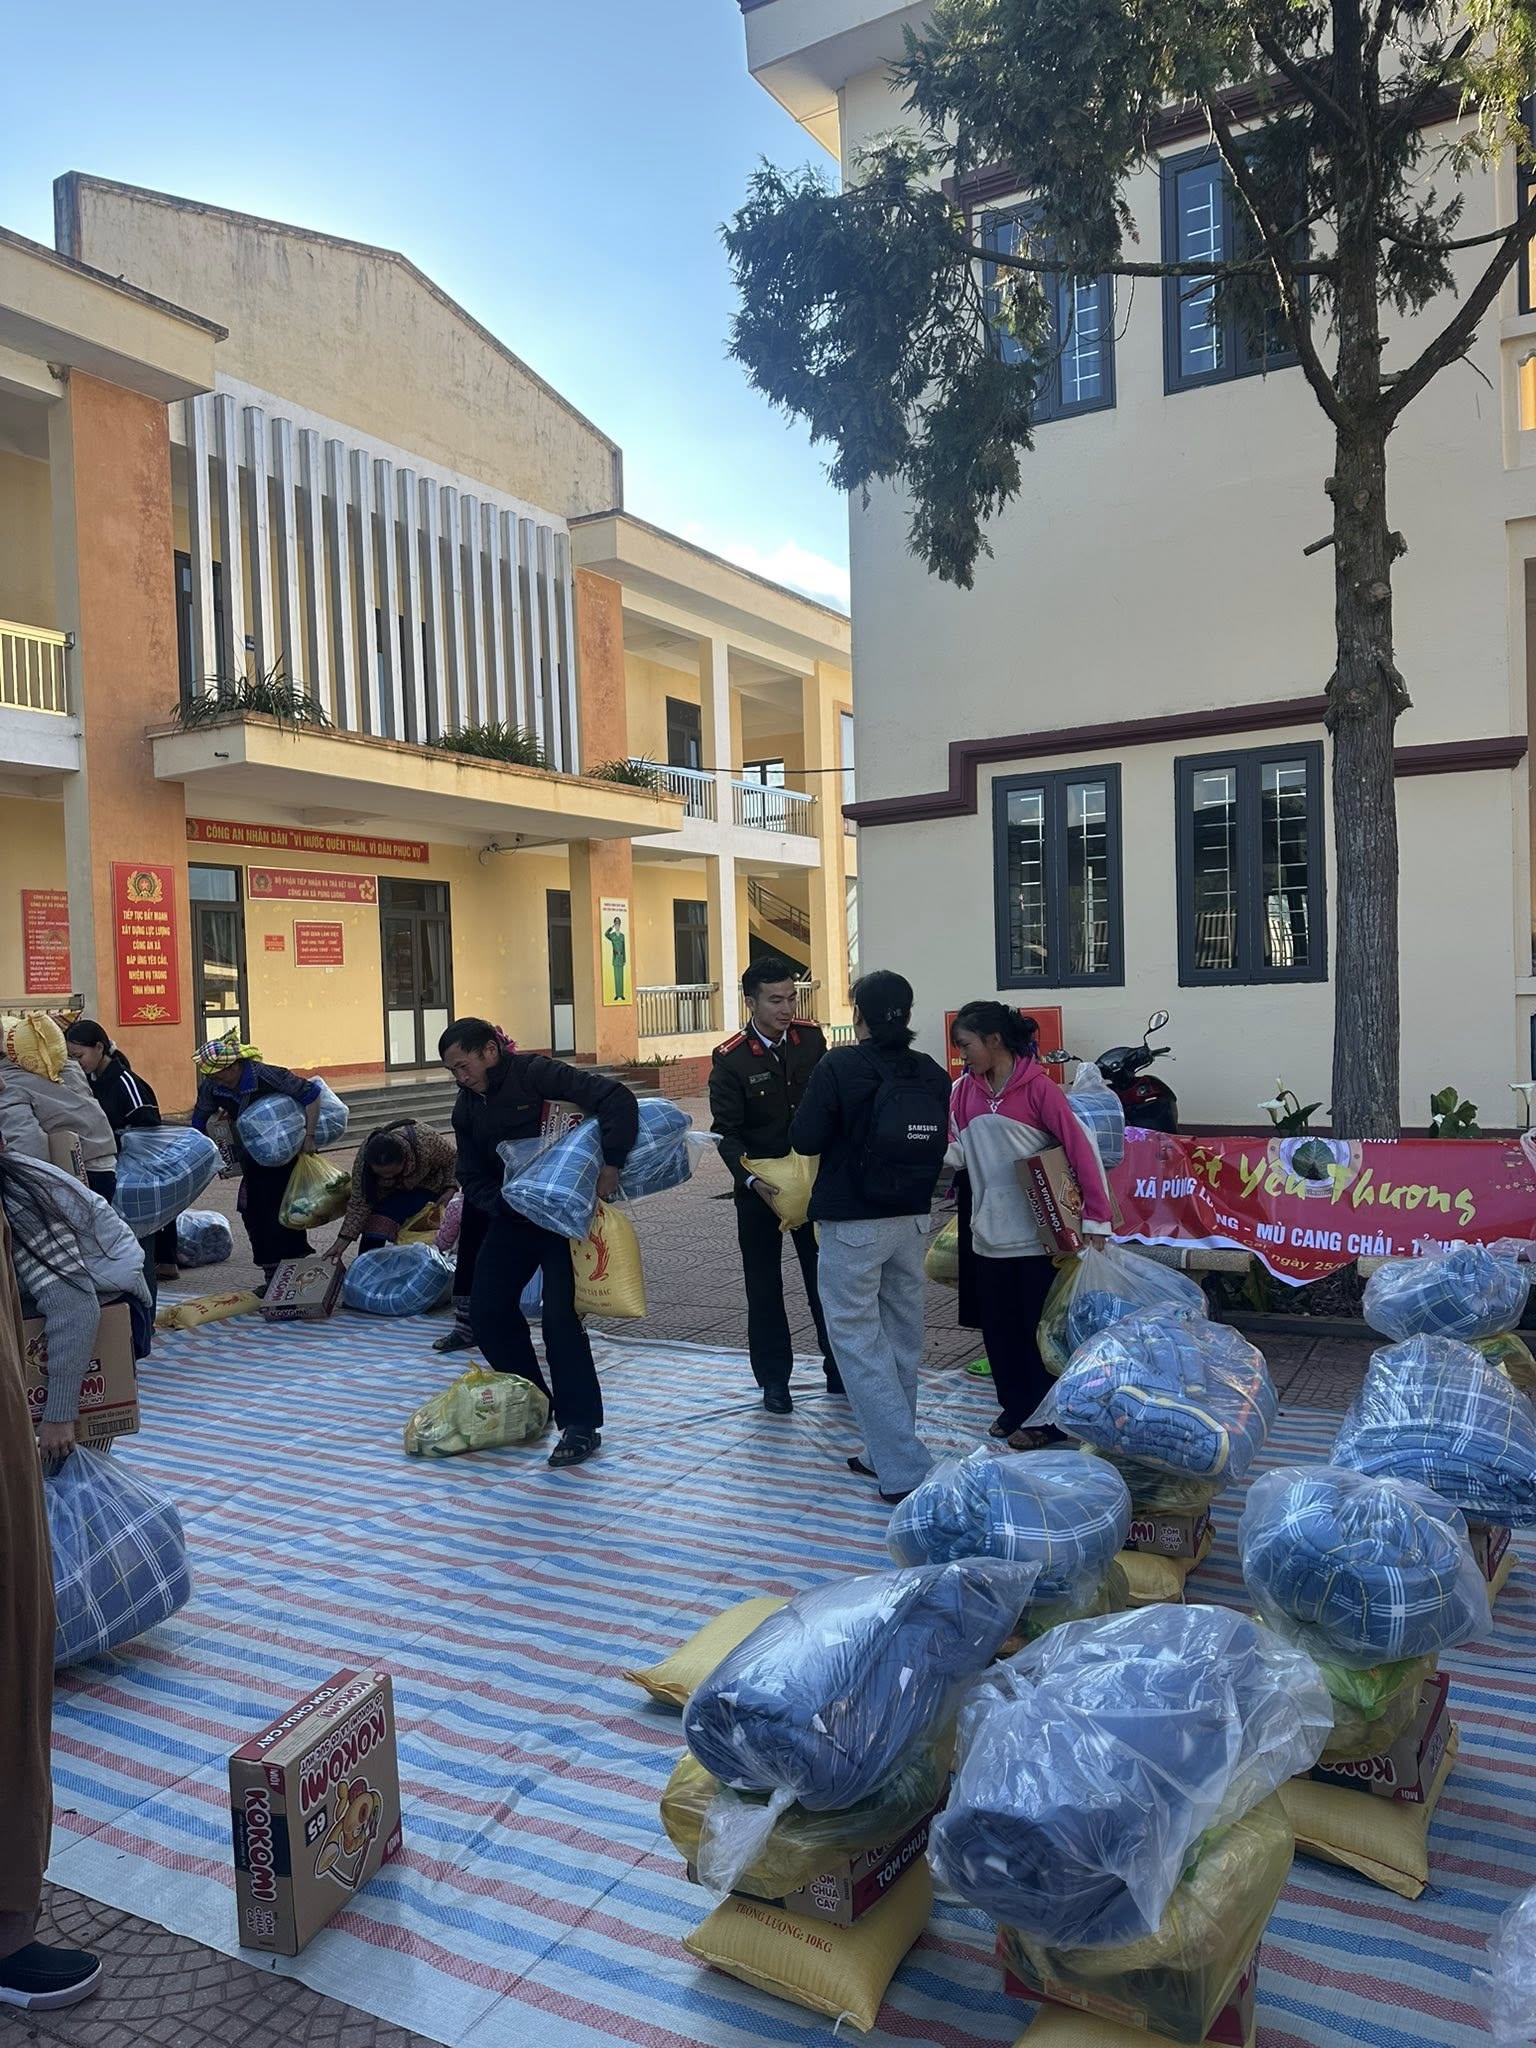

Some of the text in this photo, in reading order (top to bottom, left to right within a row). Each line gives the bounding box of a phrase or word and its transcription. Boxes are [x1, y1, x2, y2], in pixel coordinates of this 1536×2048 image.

[206, 823, 230, 839] CÔNG
[232, 828, 245, 841] AN
[246, 828, 270, 844] NHÂN
[271, 830, 288, 845] DÂN
[303, 834, 325, 849] NƯỚC
[326, 836, 346, 851] QUÊN
[369, 840, 377, 854] VÌ
[378, 843, 392, 856] DÂN
[393, 845, 411, 860] PHỤC
[123, 907, 133, 920] TIẾP
[134, 911, 143, 921] TỤC
[122, 924, 131, 935] XÂY
[132, 926, 145, 937] DỰNG
[146, 926, 155, 937] LỰC
[133, 940, 146, 950] CÔNG
[147, 941, 153, 950] AN
[907, 1132, 930, 1141] Galaxy
[908, 1124, 938, 1132] SAMSUNG
[1240, 1153, 1307, 1200] Yêu
[1025, 1186, 1047, 1228] KOKOMI
[1034, 1168, 1062, 1233] TÔM CHUA CAY
[1134, 1176, 1157, 1198] XÃ
[1256, 1221, 1286, 1245] MÙ
[1291, 1227, 1343, 1252] CANG
[1347, 1229, 1392, 1257] CHẢI
[1271, 1253, 1310, 1271] ngày
[309, 1686, 339, 1705] TÔM
[317, 1680, 372, 1720] KOKOMI
[278, 1705, 314, 1729] CHUA
[256, 1728, 282, 1749] CAY
[300, 1705, 387, 1816] KOKOMI
[308, 1812, 327, 1842] 65
[245, 1787, 277, 1901] KOKOMI
[876, 1855, 902, 1888] TÔM
[901, 1828, 928, 1863] CHUA
[810, 1883, 840, 1900] CHUA
[815, 1897, 838, 1911] CAY
[255, 1906, 265, 1937] CHUA
[264, 1910, 274, 1937] TÔM
[735, 1902, 766, 1923] TRỌNG
[805, 1933, 833, 1954] 10KG
